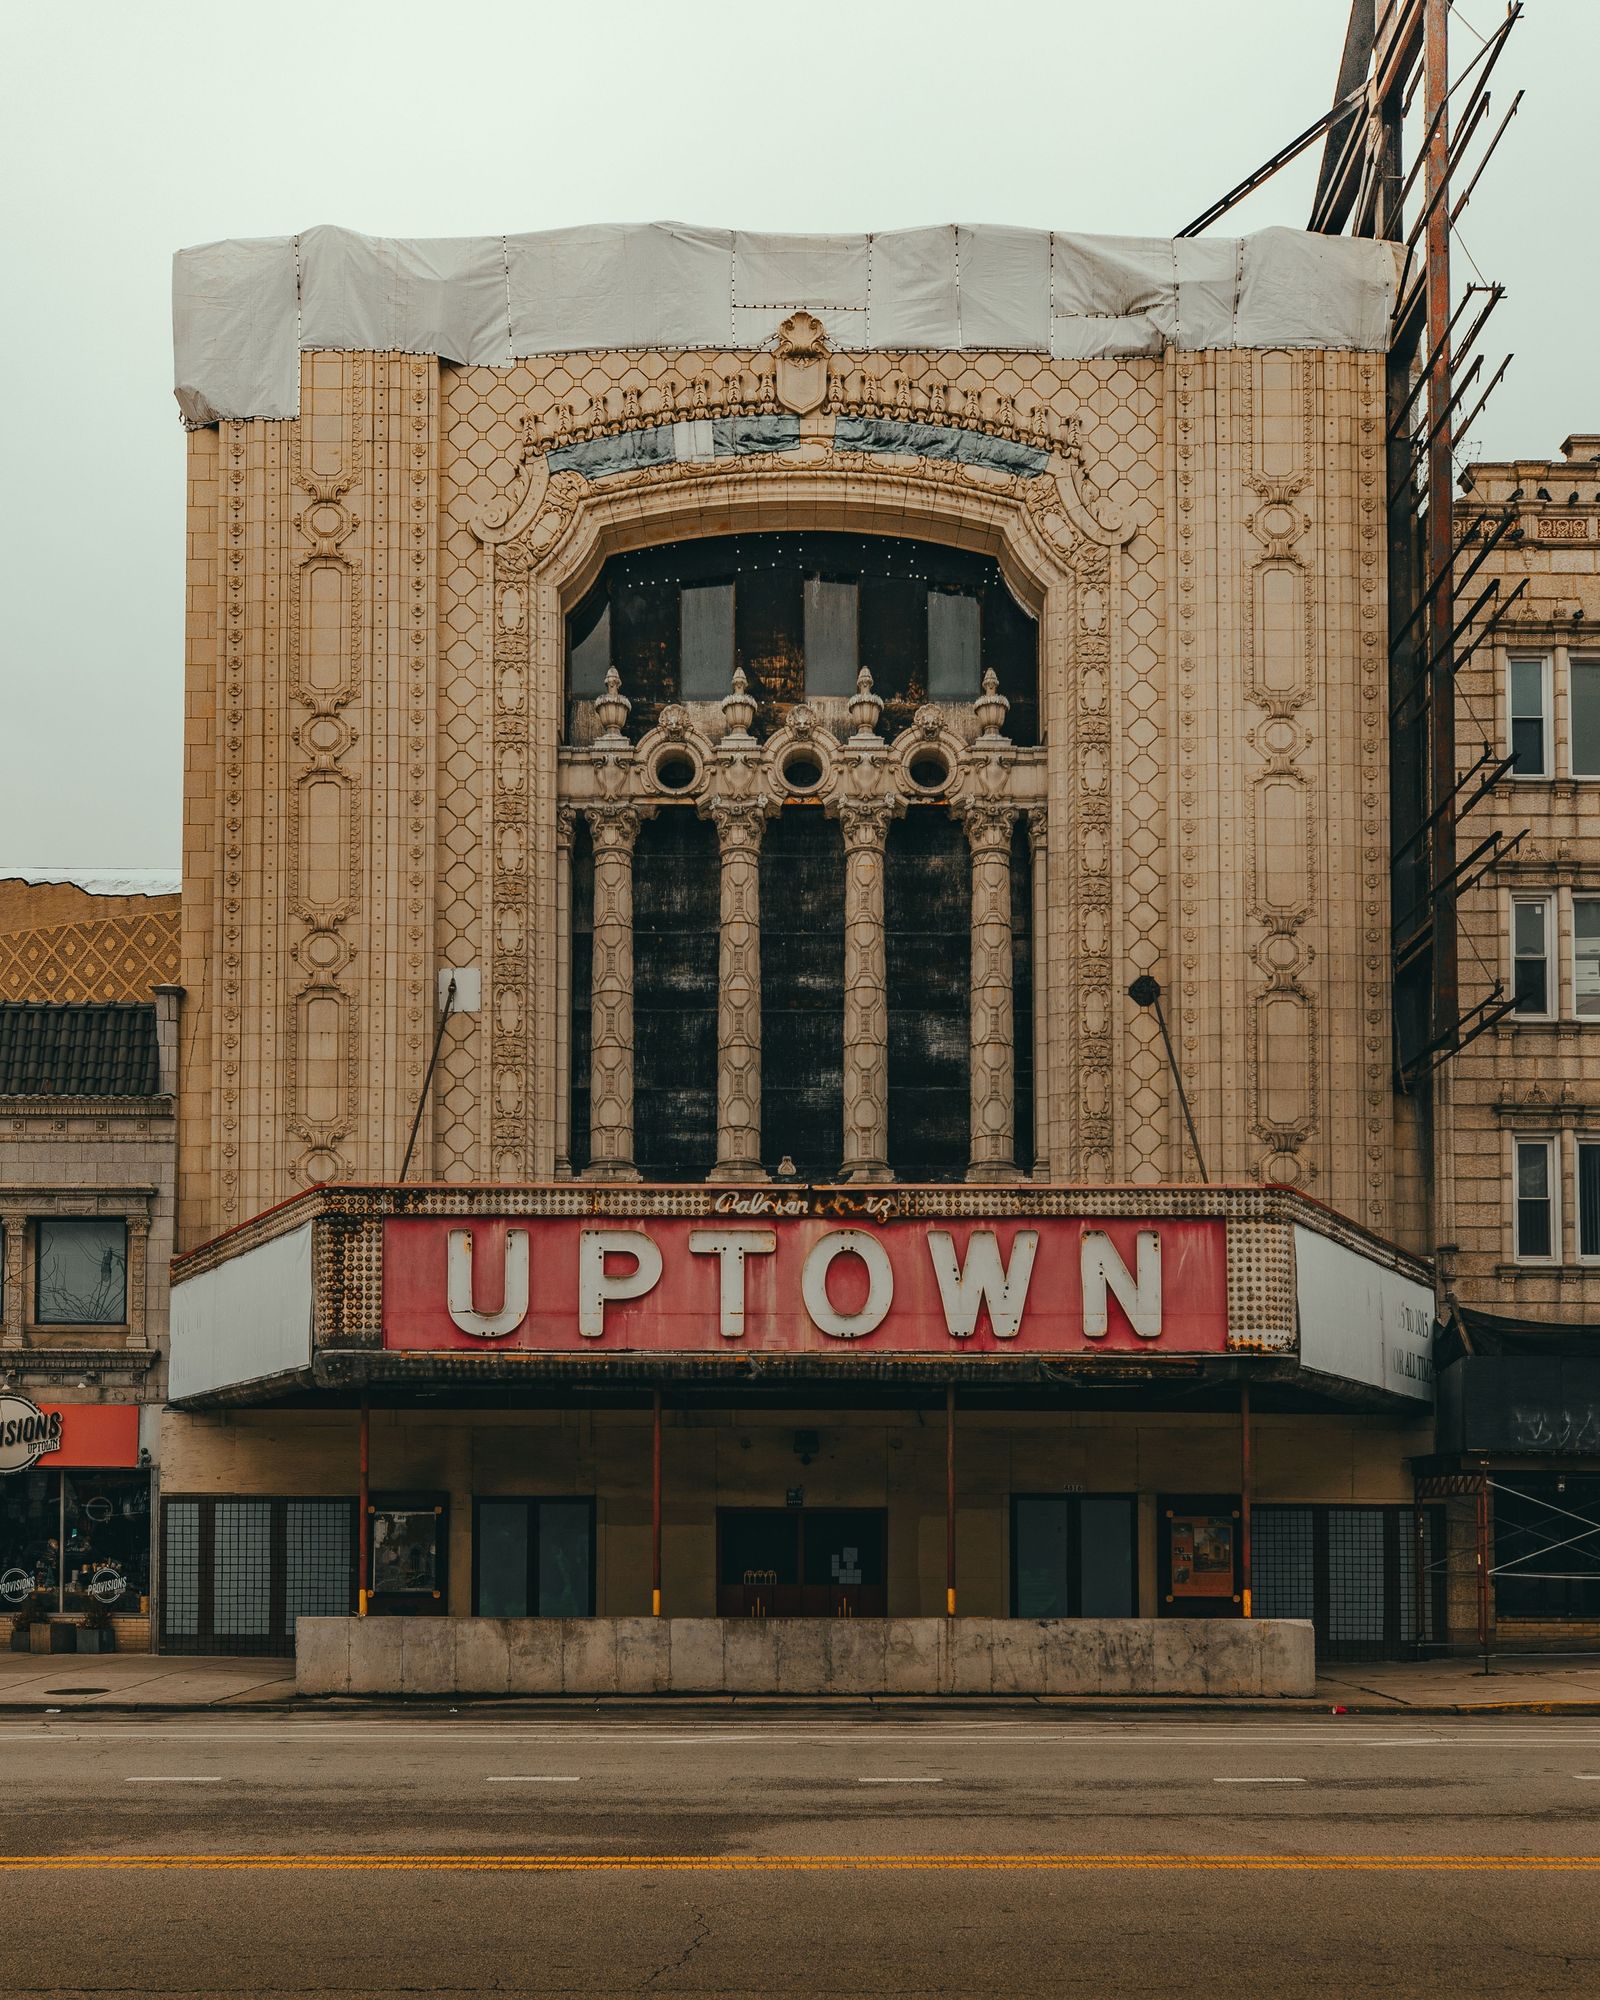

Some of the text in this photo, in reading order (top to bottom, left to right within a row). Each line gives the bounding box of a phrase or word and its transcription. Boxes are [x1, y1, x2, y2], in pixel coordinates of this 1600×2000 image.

[447, 1228, 1162, 1338] UPTOWN
[27, 1440, 59, 1454] UPTOWN
[88, 1577, 127, 1595] PROVISIONS
